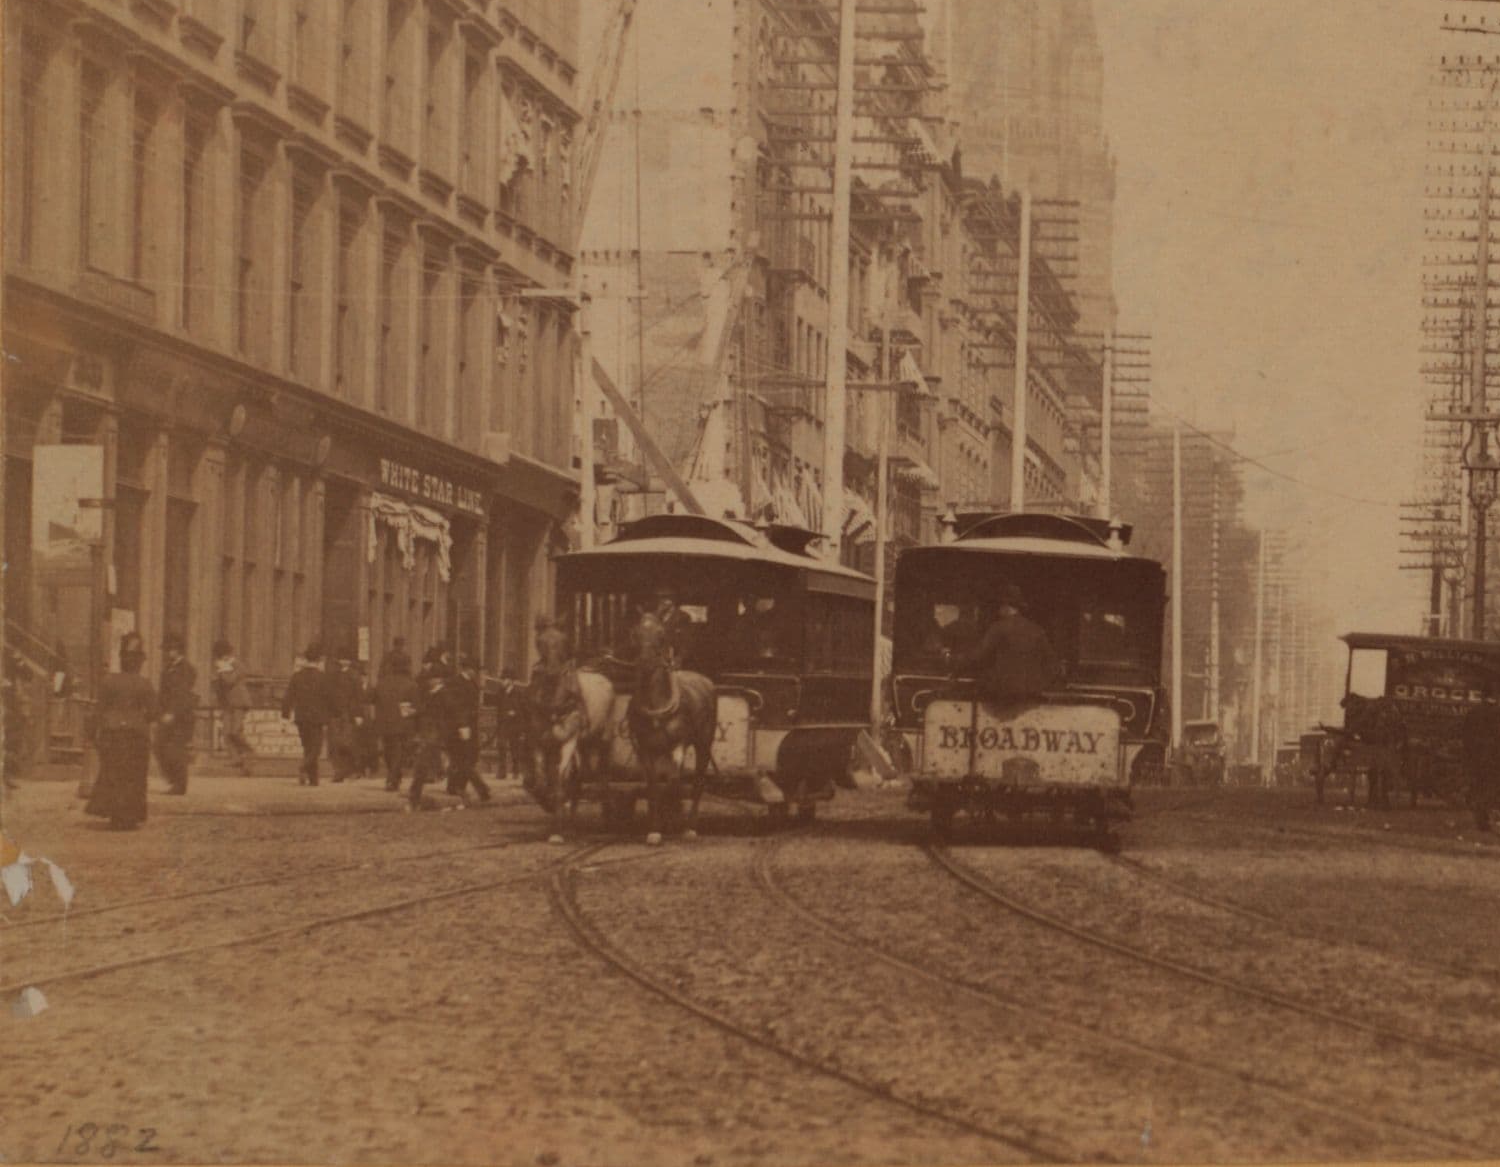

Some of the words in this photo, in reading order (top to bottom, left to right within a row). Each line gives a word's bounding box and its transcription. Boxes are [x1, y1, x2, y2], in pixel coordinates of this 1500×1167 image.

[380, 458, 420, 494] WHITE
[423, 474, 454, 504] STAR
[457, 485, 485, 515] LINE
[938, 726, 1104, 755] BROADWAY
[57, 1122, 160, 1158] 1882
